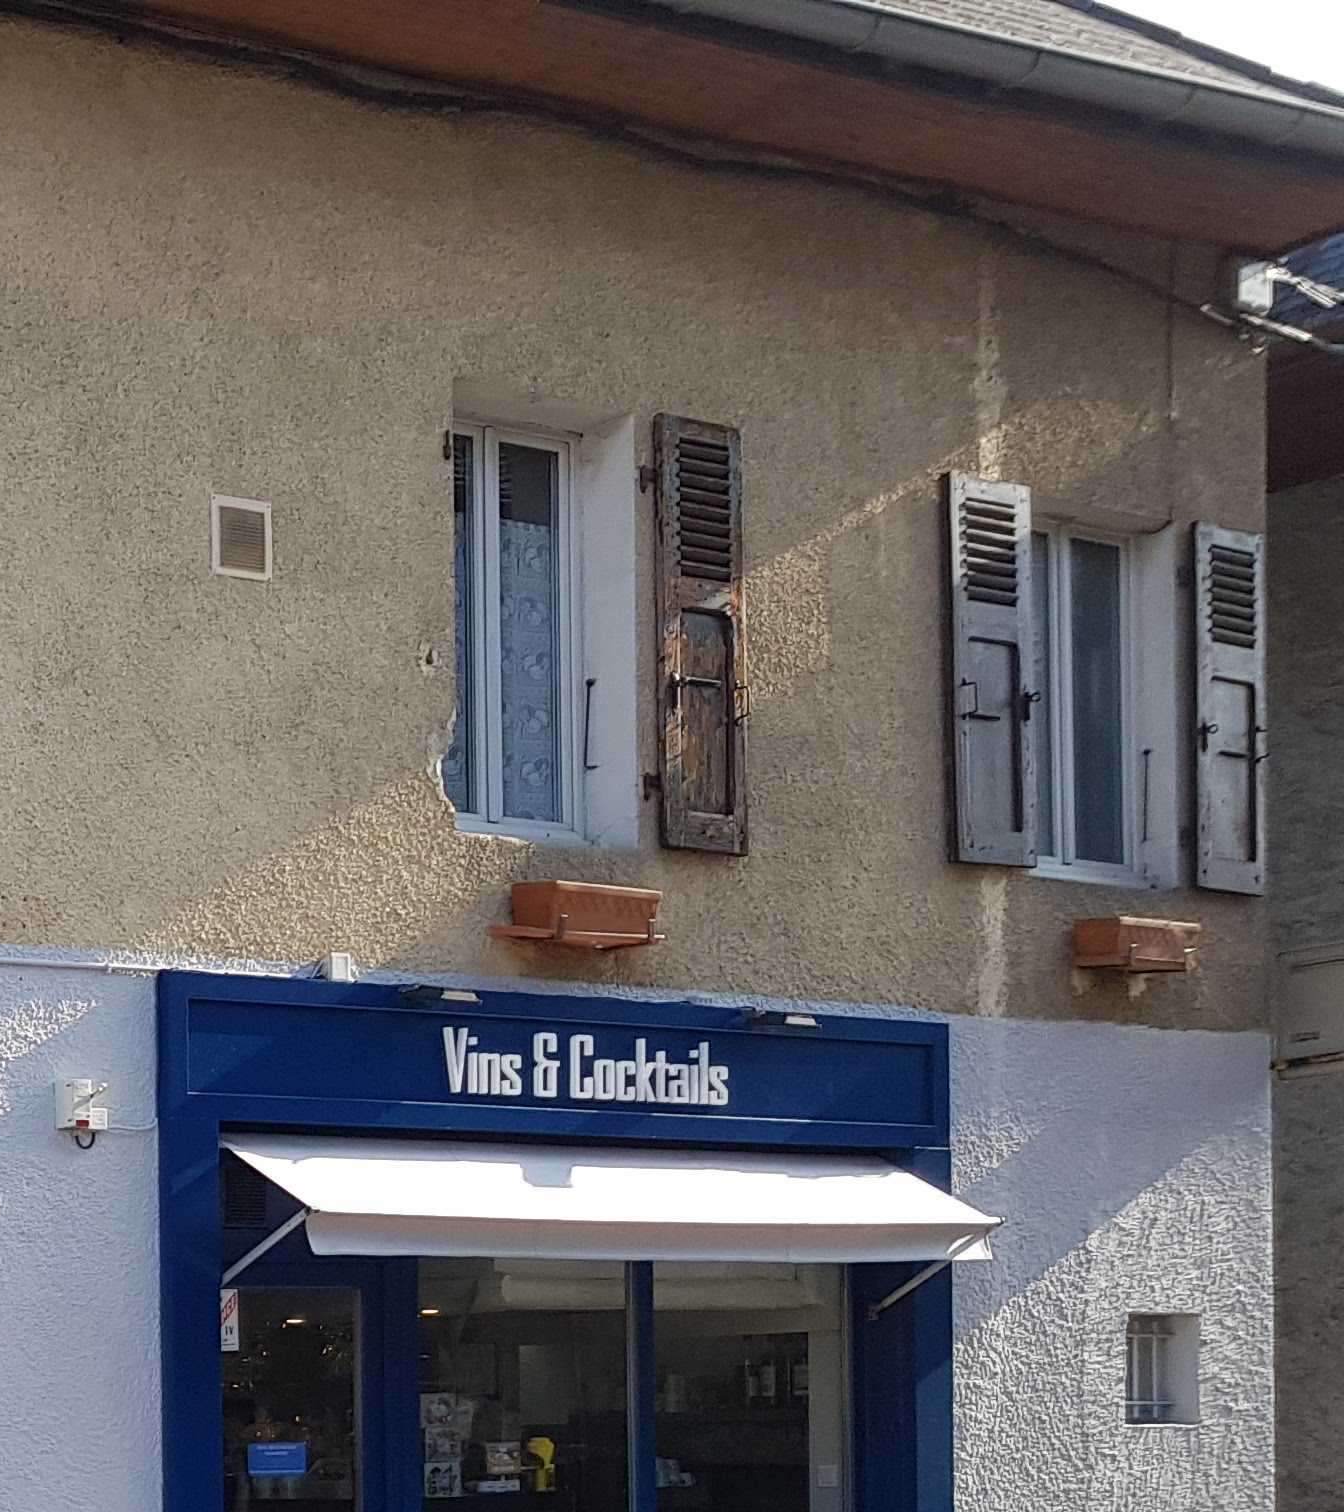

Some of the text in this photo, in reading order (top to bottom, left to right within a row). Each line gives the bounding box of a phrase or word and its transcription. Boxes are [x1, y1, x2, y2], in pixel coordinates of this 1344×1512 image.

[442, 1026, 729, 1106] Vins & Cocktails
